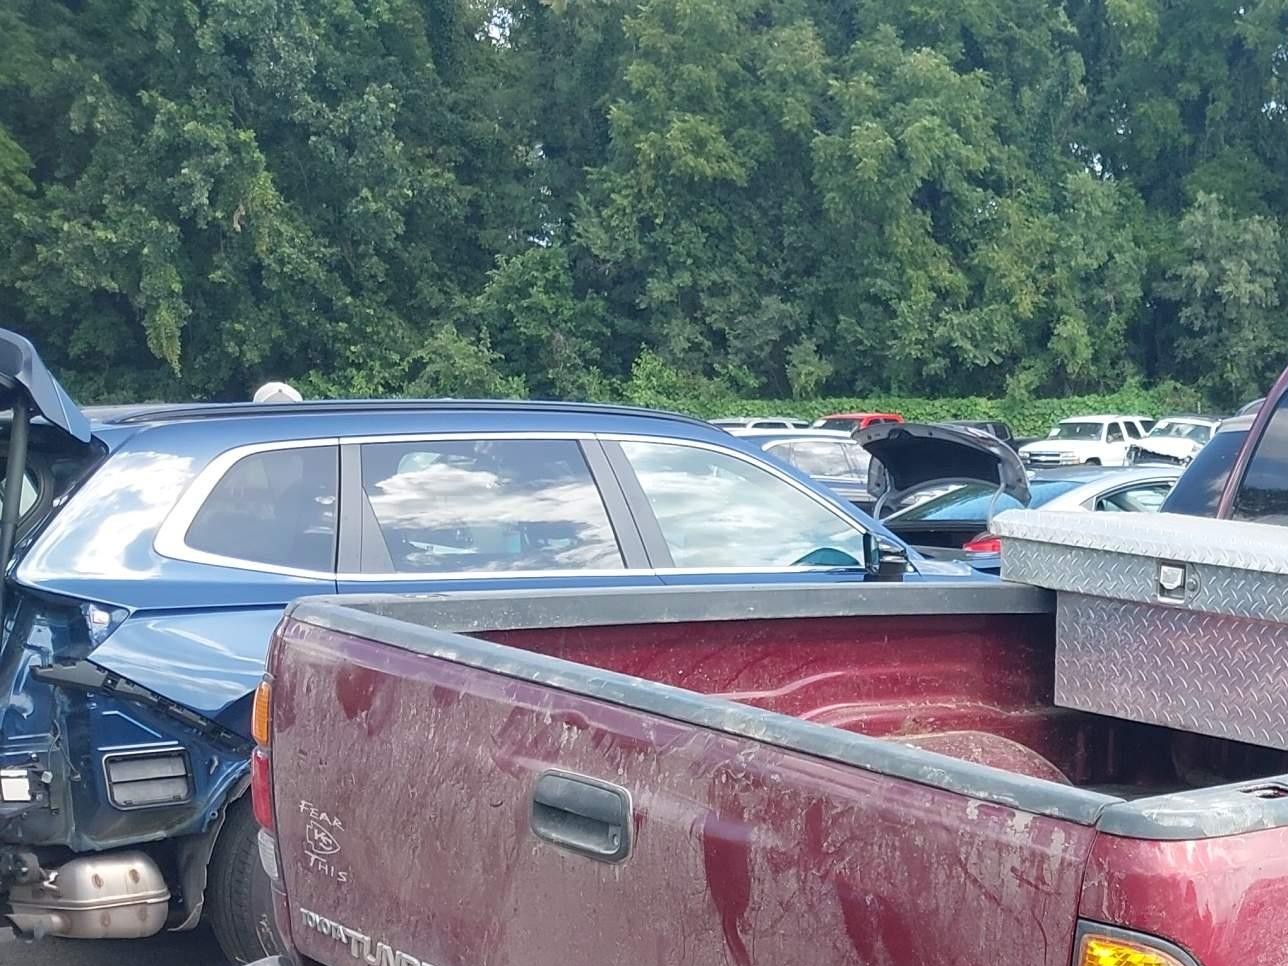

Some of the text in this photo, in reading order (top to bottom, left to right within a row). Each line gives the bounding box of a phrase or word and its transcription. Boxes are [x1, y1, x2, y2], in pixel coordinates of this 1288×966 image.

[299, 799, 345, 832] FEAR
[304, 850, 348, 882] THIS
[300, 907, 348, 944] TOYOTA
